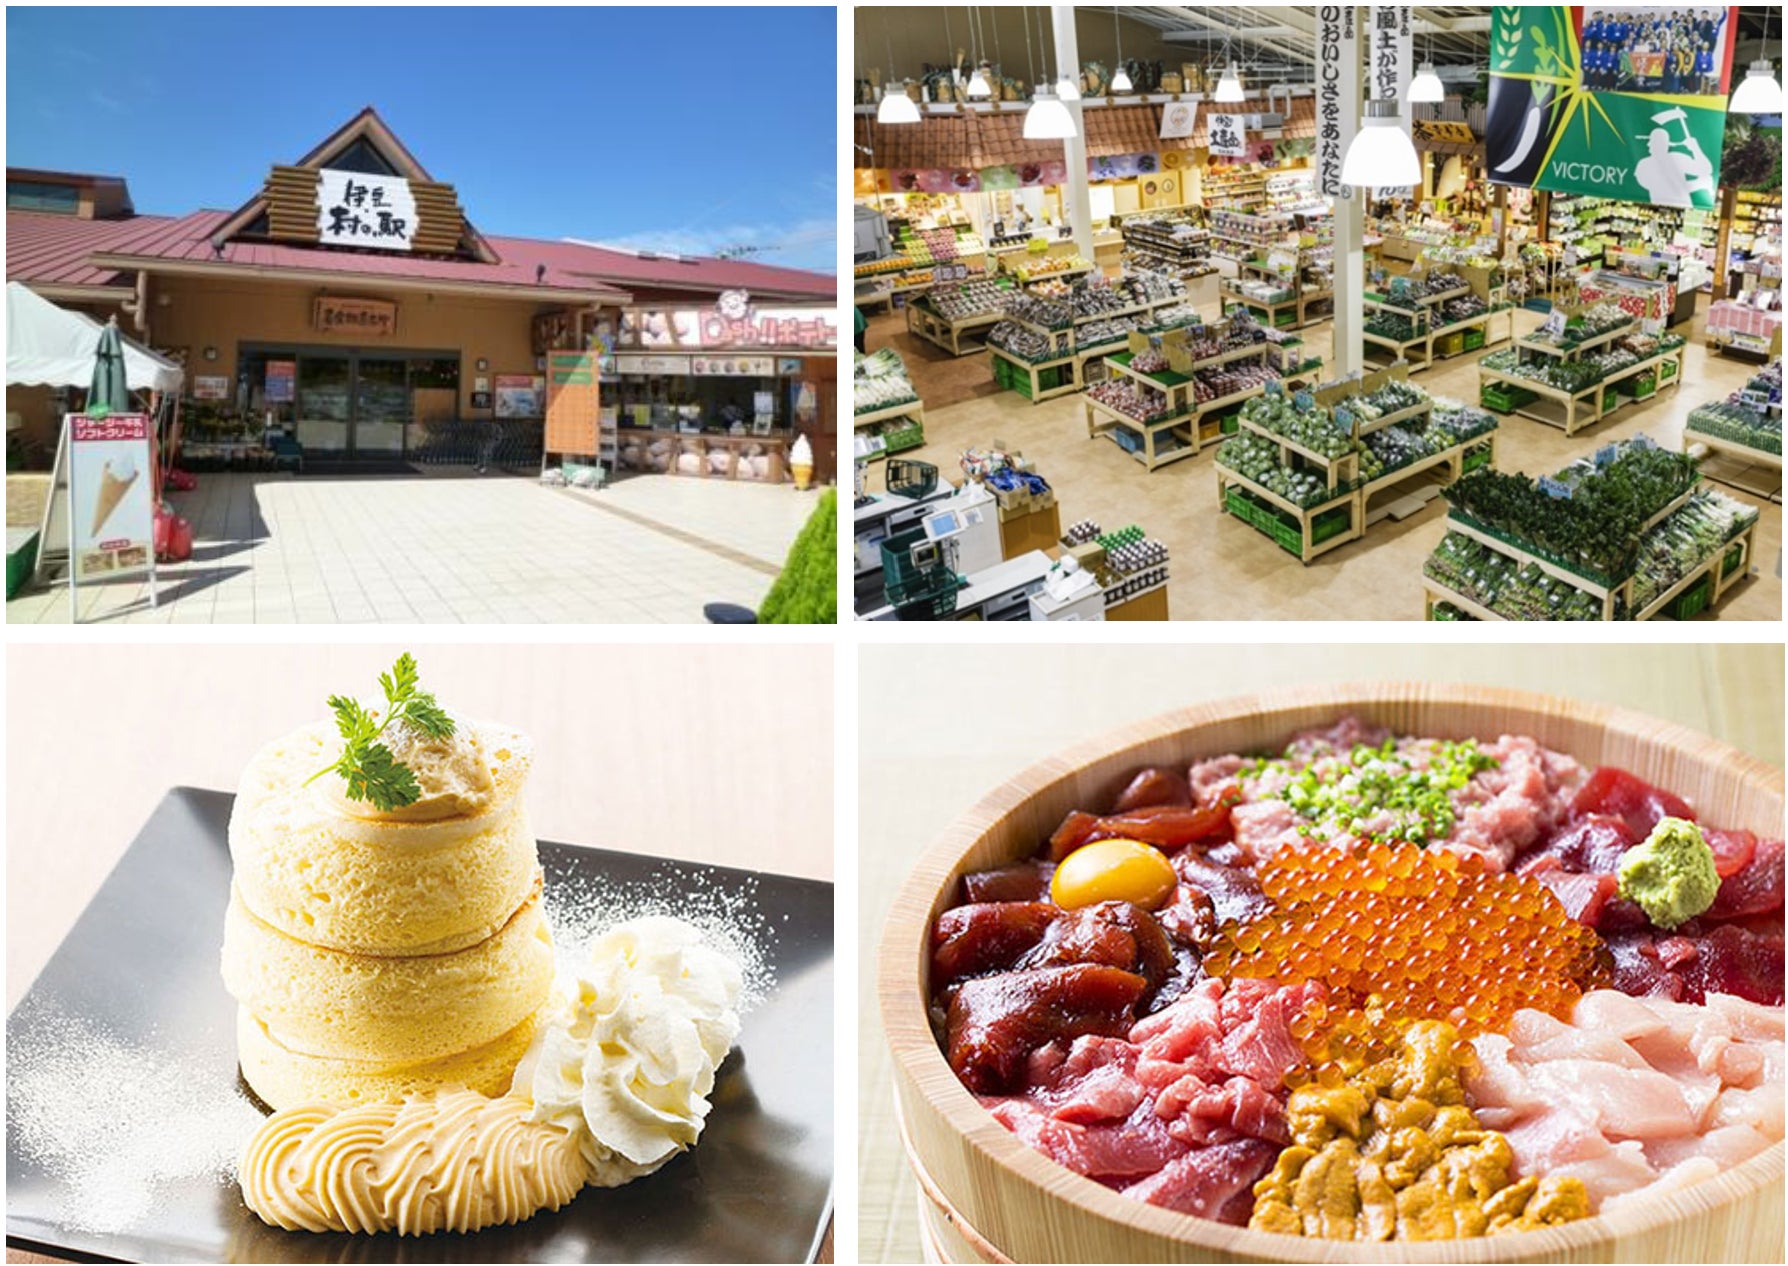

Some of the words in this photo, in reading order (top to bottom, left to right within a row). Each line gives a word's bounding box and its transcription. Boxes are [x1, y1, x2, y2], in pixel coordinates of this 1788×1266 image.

[1552, 160, 1628, 186] VICTORY
[76, 427, 144, 439] ソフトクリーム
